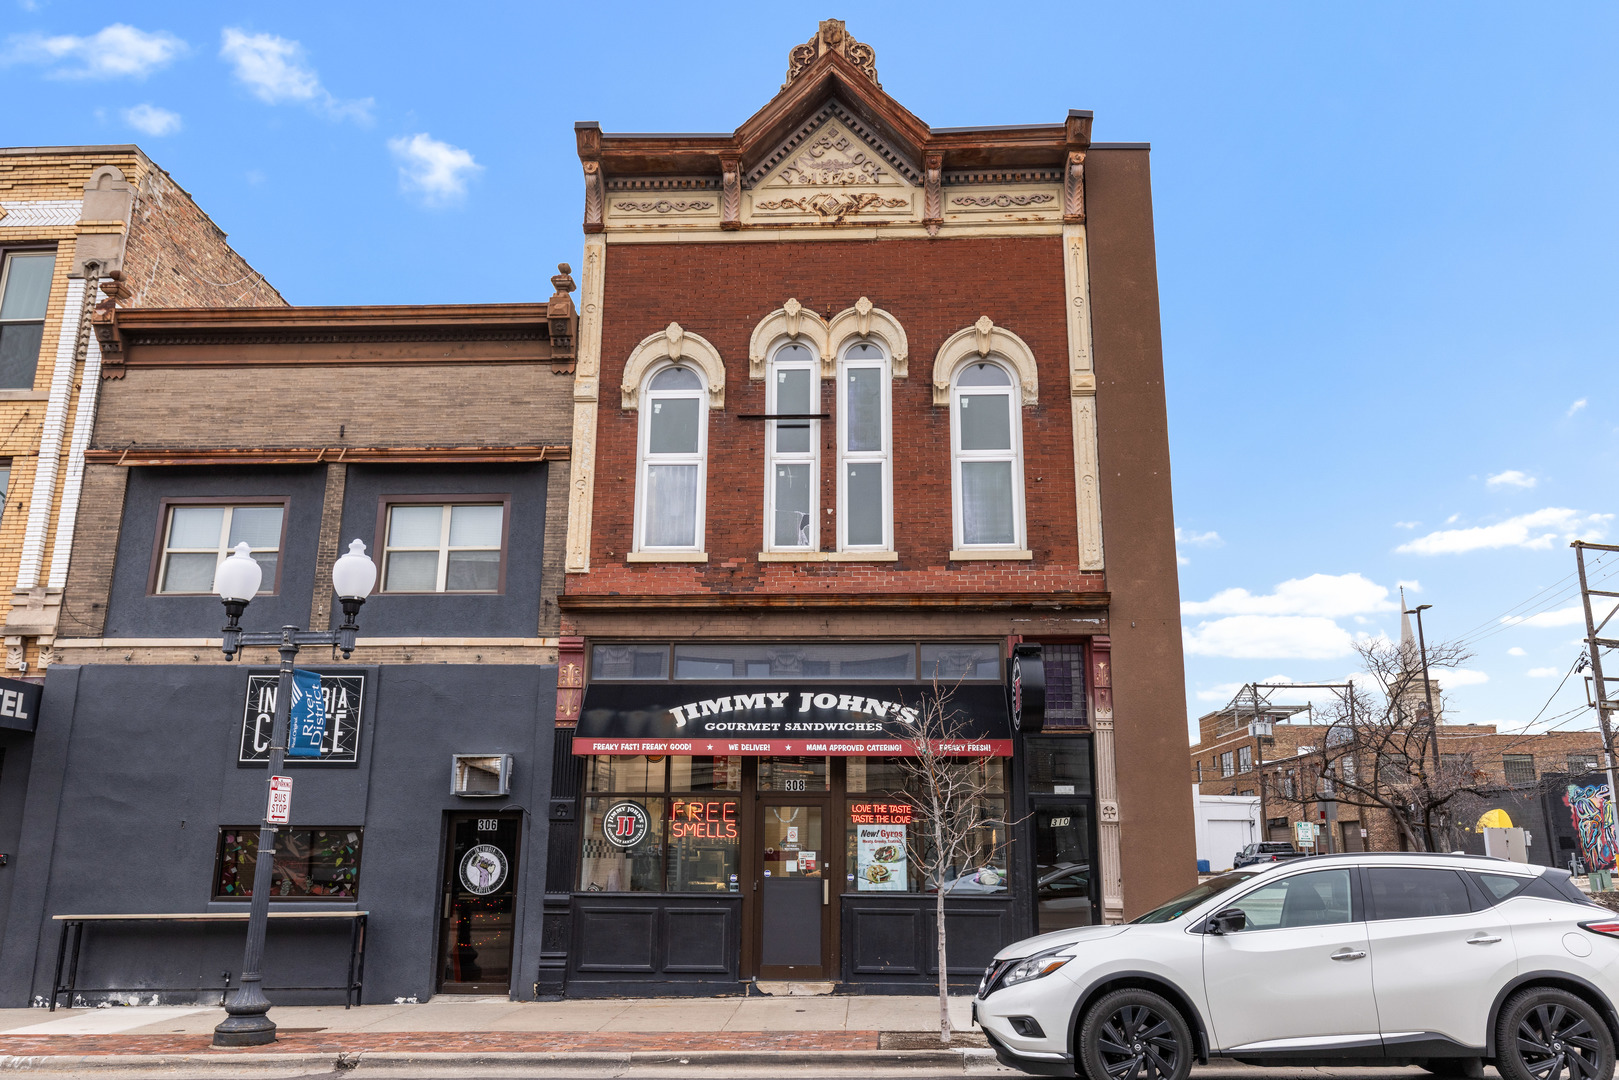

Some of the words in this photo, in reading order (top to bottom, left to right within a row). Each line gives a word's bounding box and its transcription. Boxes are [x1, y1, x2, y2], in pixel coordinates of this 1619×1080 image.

[832, 134, 888, 184] BLOCK
[811, 172, 856, 184] 1879
[0, 688, 28, 719] EL
[257, 687, 348, 714] INBIA
[302, 690, 314, 736] River
[310, 684, 324, 746] District
[669, 692, 789, 728] JIMMY
[799, 693, 919, 725] JOHN'S
[704, 722, 781, 731] GOURMET
[784, 722, 883, 731] SANDWICHES
[593, 743, 619, 751] FREAKY
[620, 743, 640, 751] FAST!
[641, 743, 668, 751] FREAKY
[670, 743, 692, 751] GOOD!
[829, 744, 865, 752] APPROVED
[866, 744, 903, 752] CATERING!
[939, 744, 966, 752] FREAKY
[967, 744, 991, 752] FRESH!
[786, 780, 805, 791] 308
[274, 793, 286, 802] BUS
[271, 803, 287, 813] STOP
[672, 802, 736, 823] FREE
[851, 804, 872, 813] LOVE
[873, 804, 887, 813] THE
[888, 805, 912, 814] TASTE
[607, 806, 626, 823] JIMMY
[851, 814, 874, 823] TASTE
[875, 815, 890, 823] THE
[890, 815, 912, 824] LOVE
[478, 819, 497, 830] 306
[616, 816, 636, 836] JJ
[1052, 817, 1069, 826] 310
[672, 822, 737, 838] SMELLS
[860, 829, 880, 838] New!
[880, 829, 903, 839] Gyros
